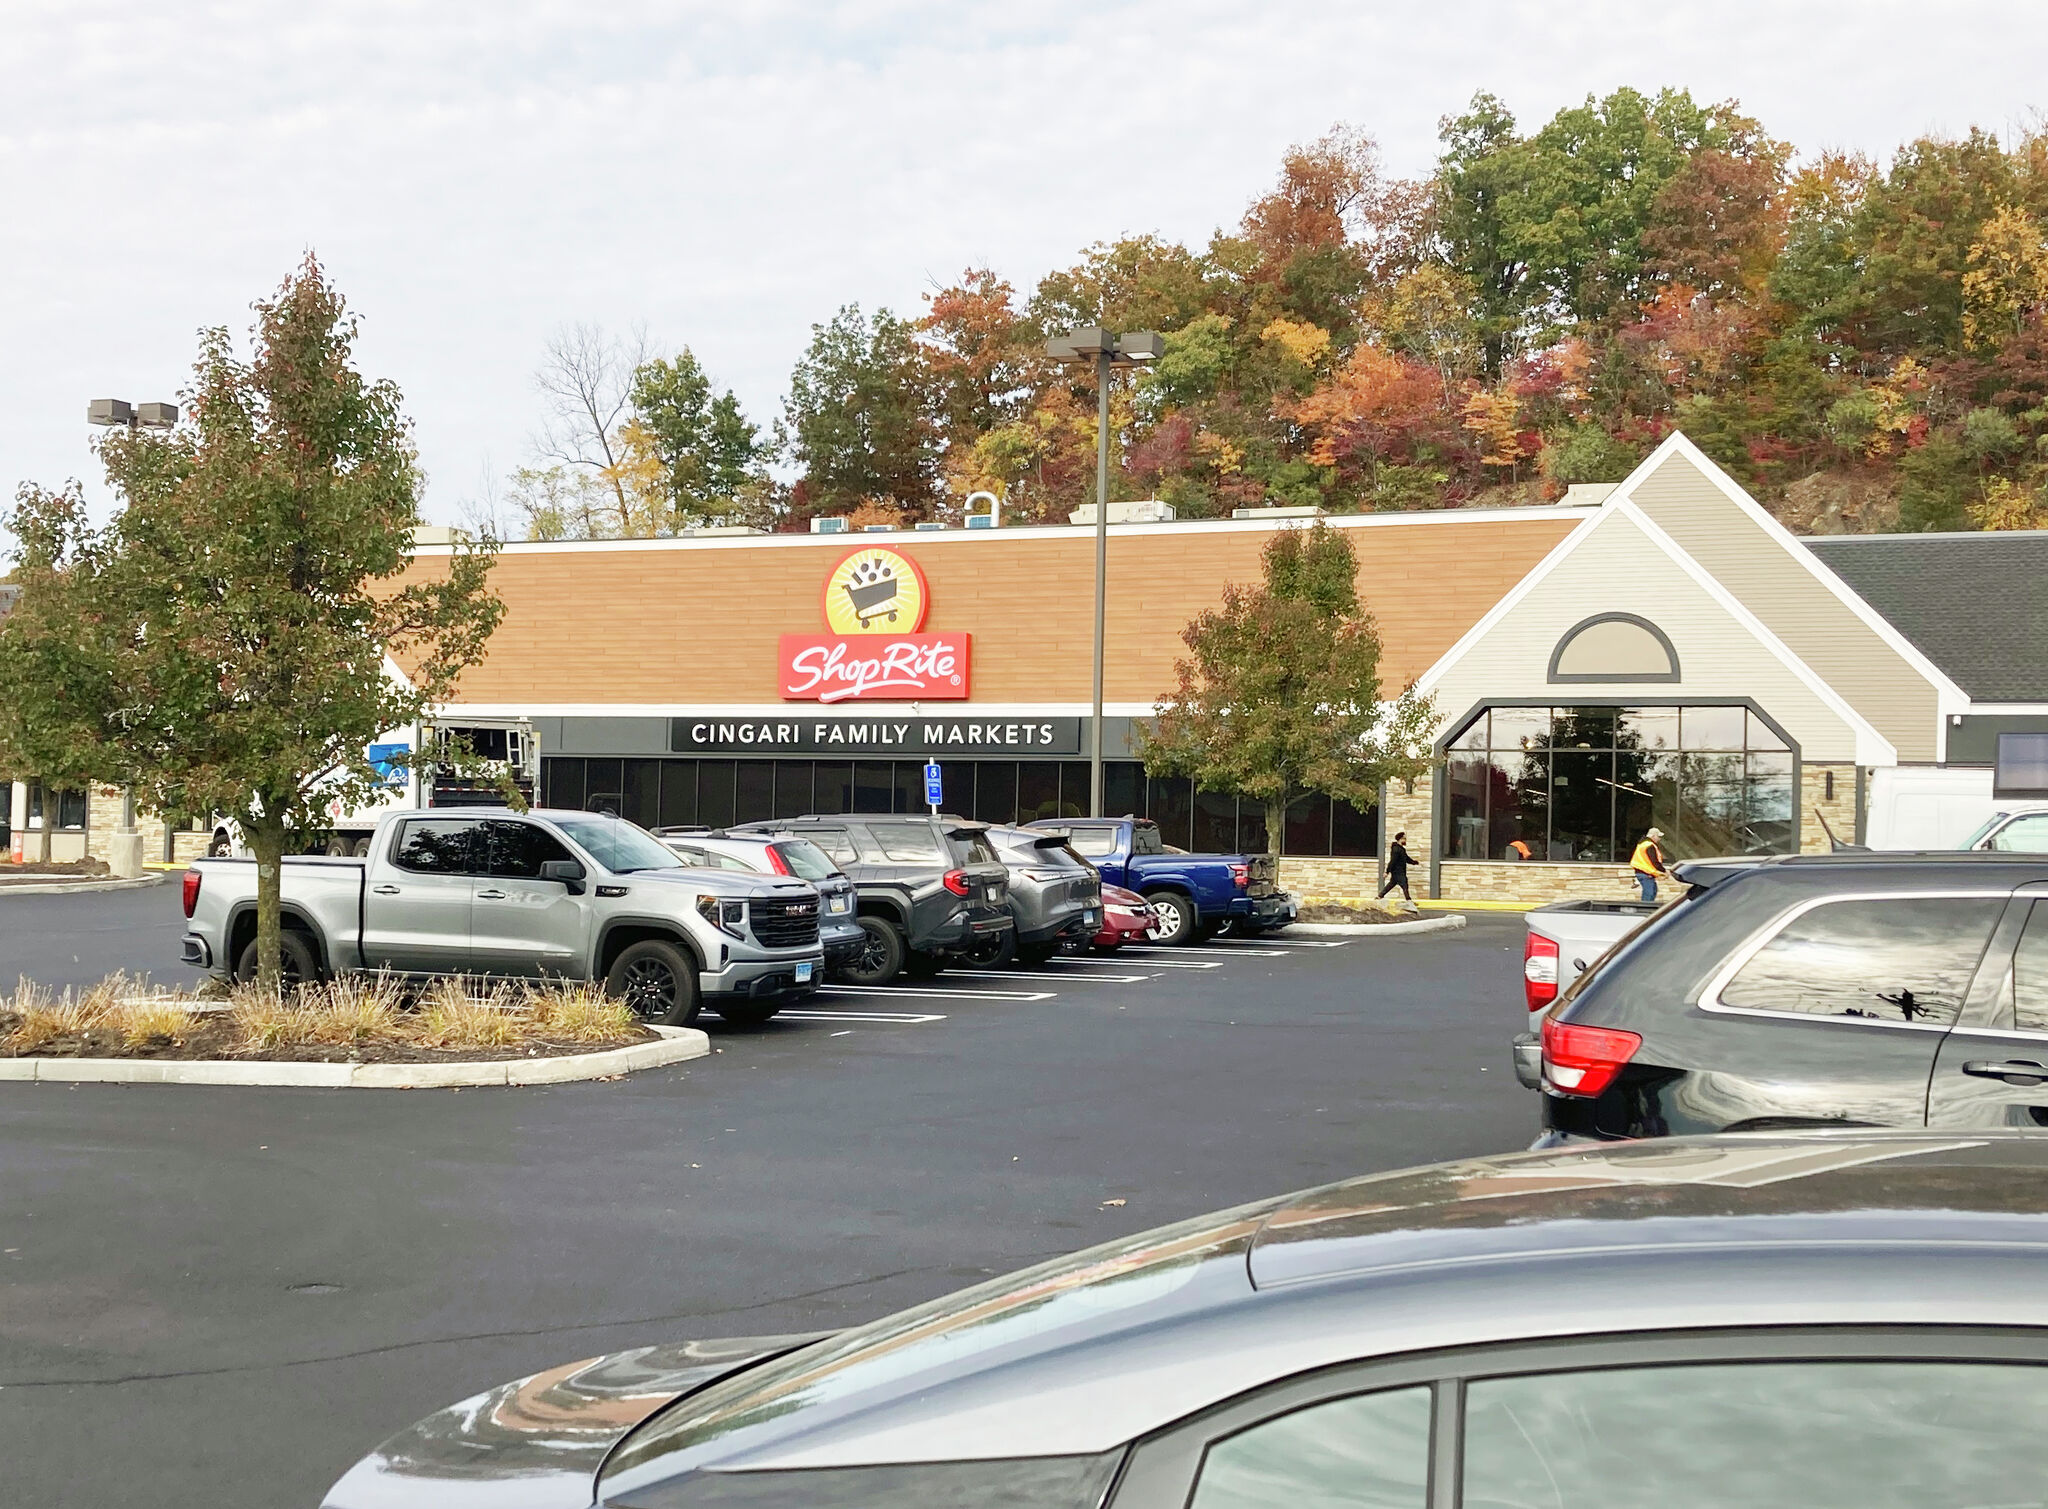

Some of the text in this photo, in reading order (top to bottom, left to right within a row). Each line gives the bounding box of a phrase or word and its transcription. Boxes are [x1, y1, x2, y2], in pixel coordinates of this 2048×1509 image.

[788, 641, 955, 698] ShopRite
[691, 723, 1054, 745] CINGARI FAMILY MARKETS
